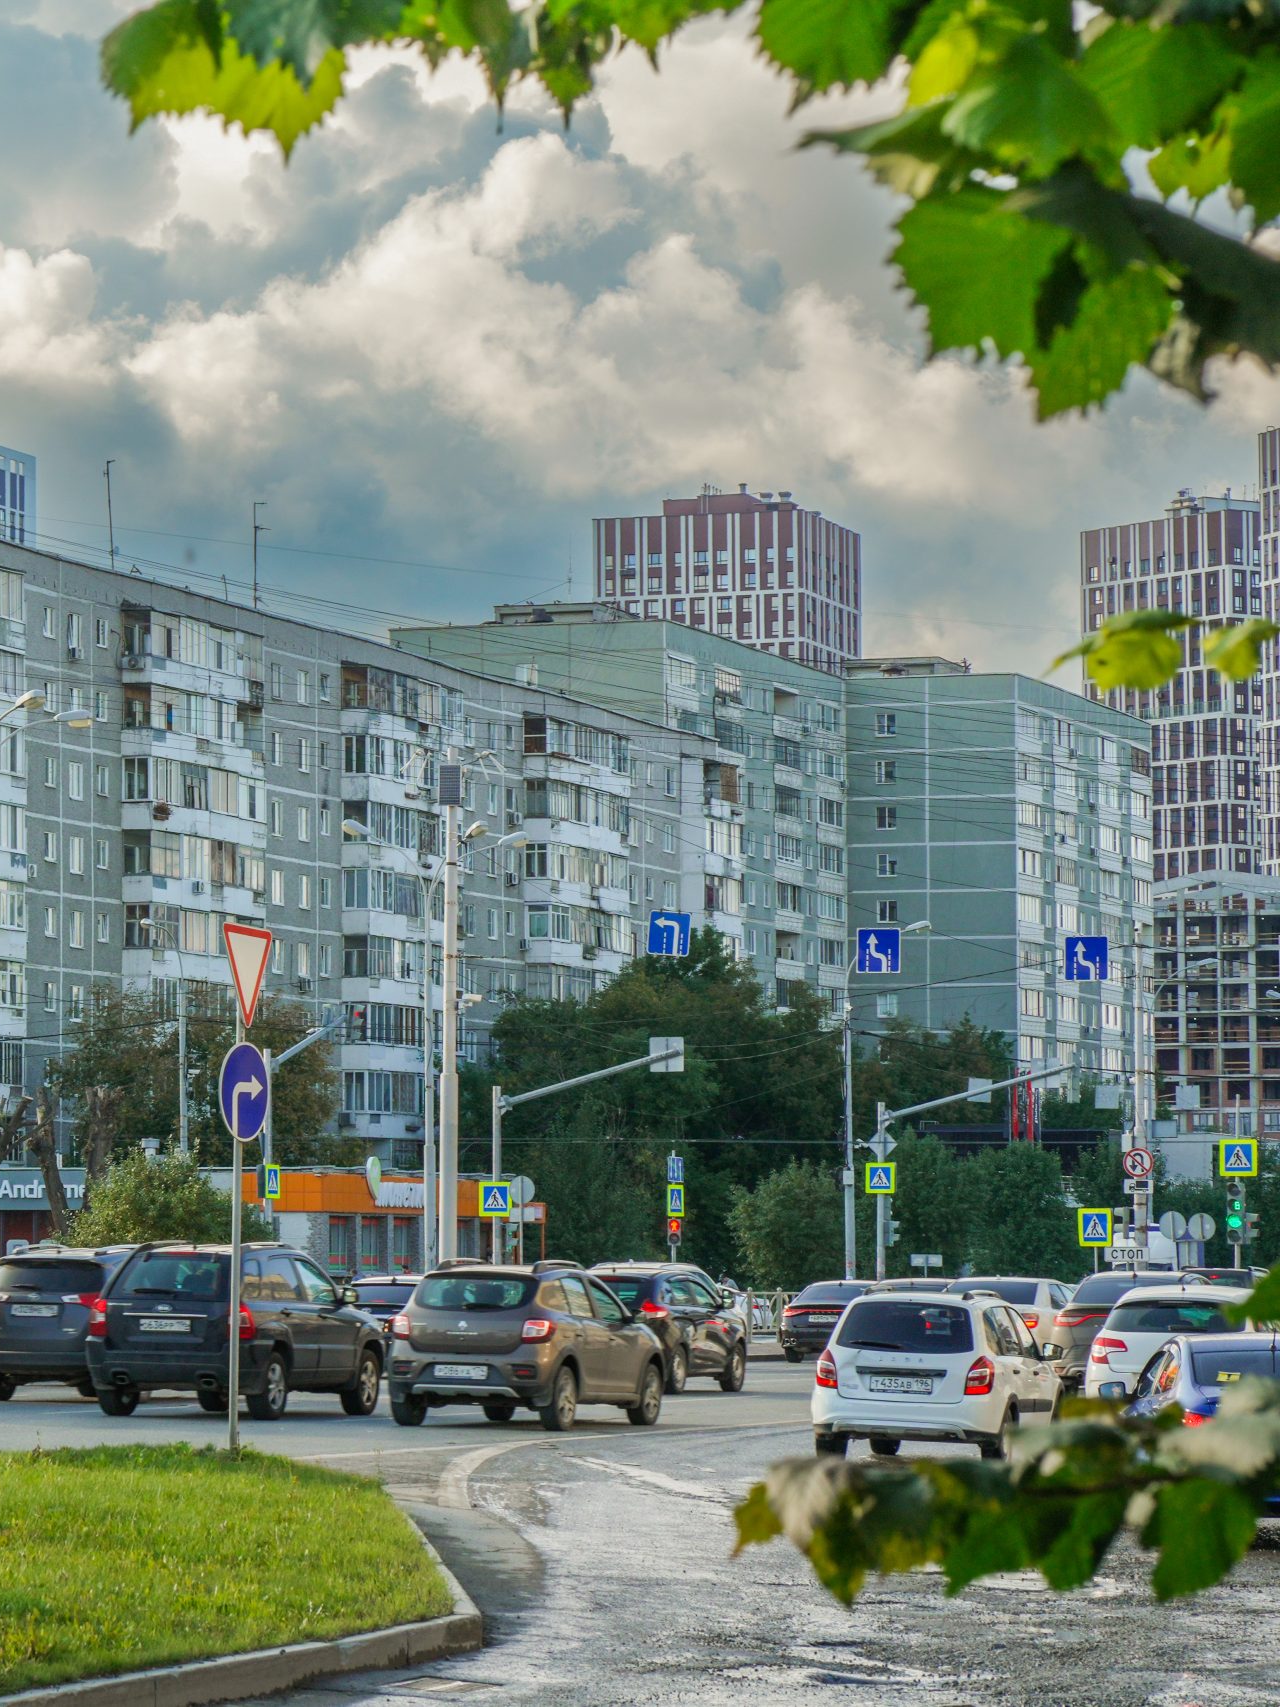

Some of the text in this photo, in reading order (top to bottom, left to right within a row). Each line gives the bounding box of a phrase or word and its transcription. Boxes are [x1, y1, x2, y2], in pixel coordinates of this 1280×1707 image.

[1111, 1249, 1144, 1260] СТОП
[874, 1378, 930, 1390] Т435АВ 196
